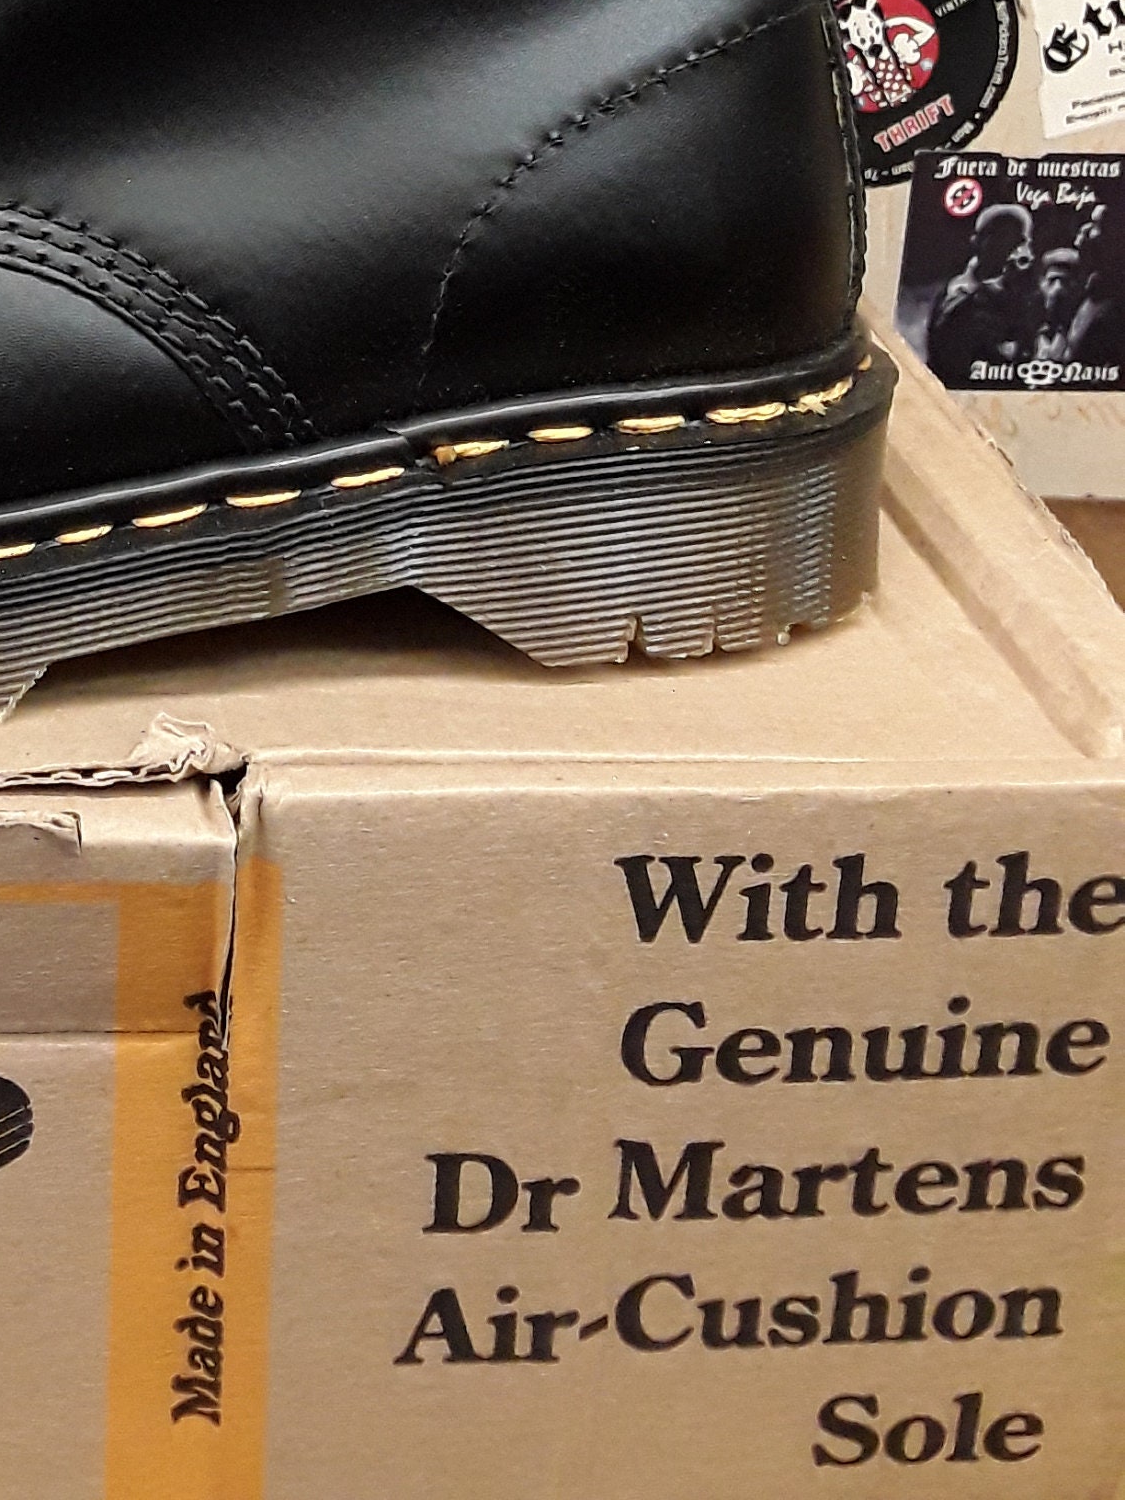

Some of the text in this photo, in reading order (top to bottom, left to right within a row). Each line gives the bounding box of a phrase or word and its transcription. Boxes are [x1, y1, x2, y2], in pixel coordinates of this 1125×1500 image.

[873, 93, 955, 153] THRIFT
[933, 155, 997, 179] Fuera
[1007, 158, 1027, 178] de
[1036, 158, 1121, 178] nuestras
[969, 360, 1014, 382] Anti
[614, 850, 1125, 944] With the
[619, 996, 1111, 1088] Genuine
[421, 1138, 1087, 1235] Dr Martens
[174, 1222, 226, 1279] in
[171, 1283, 225, 1428] Made
[393, 1266, 1064, 1366] Air-Cushion
[812, 1391, 1046, 1468] Sole
